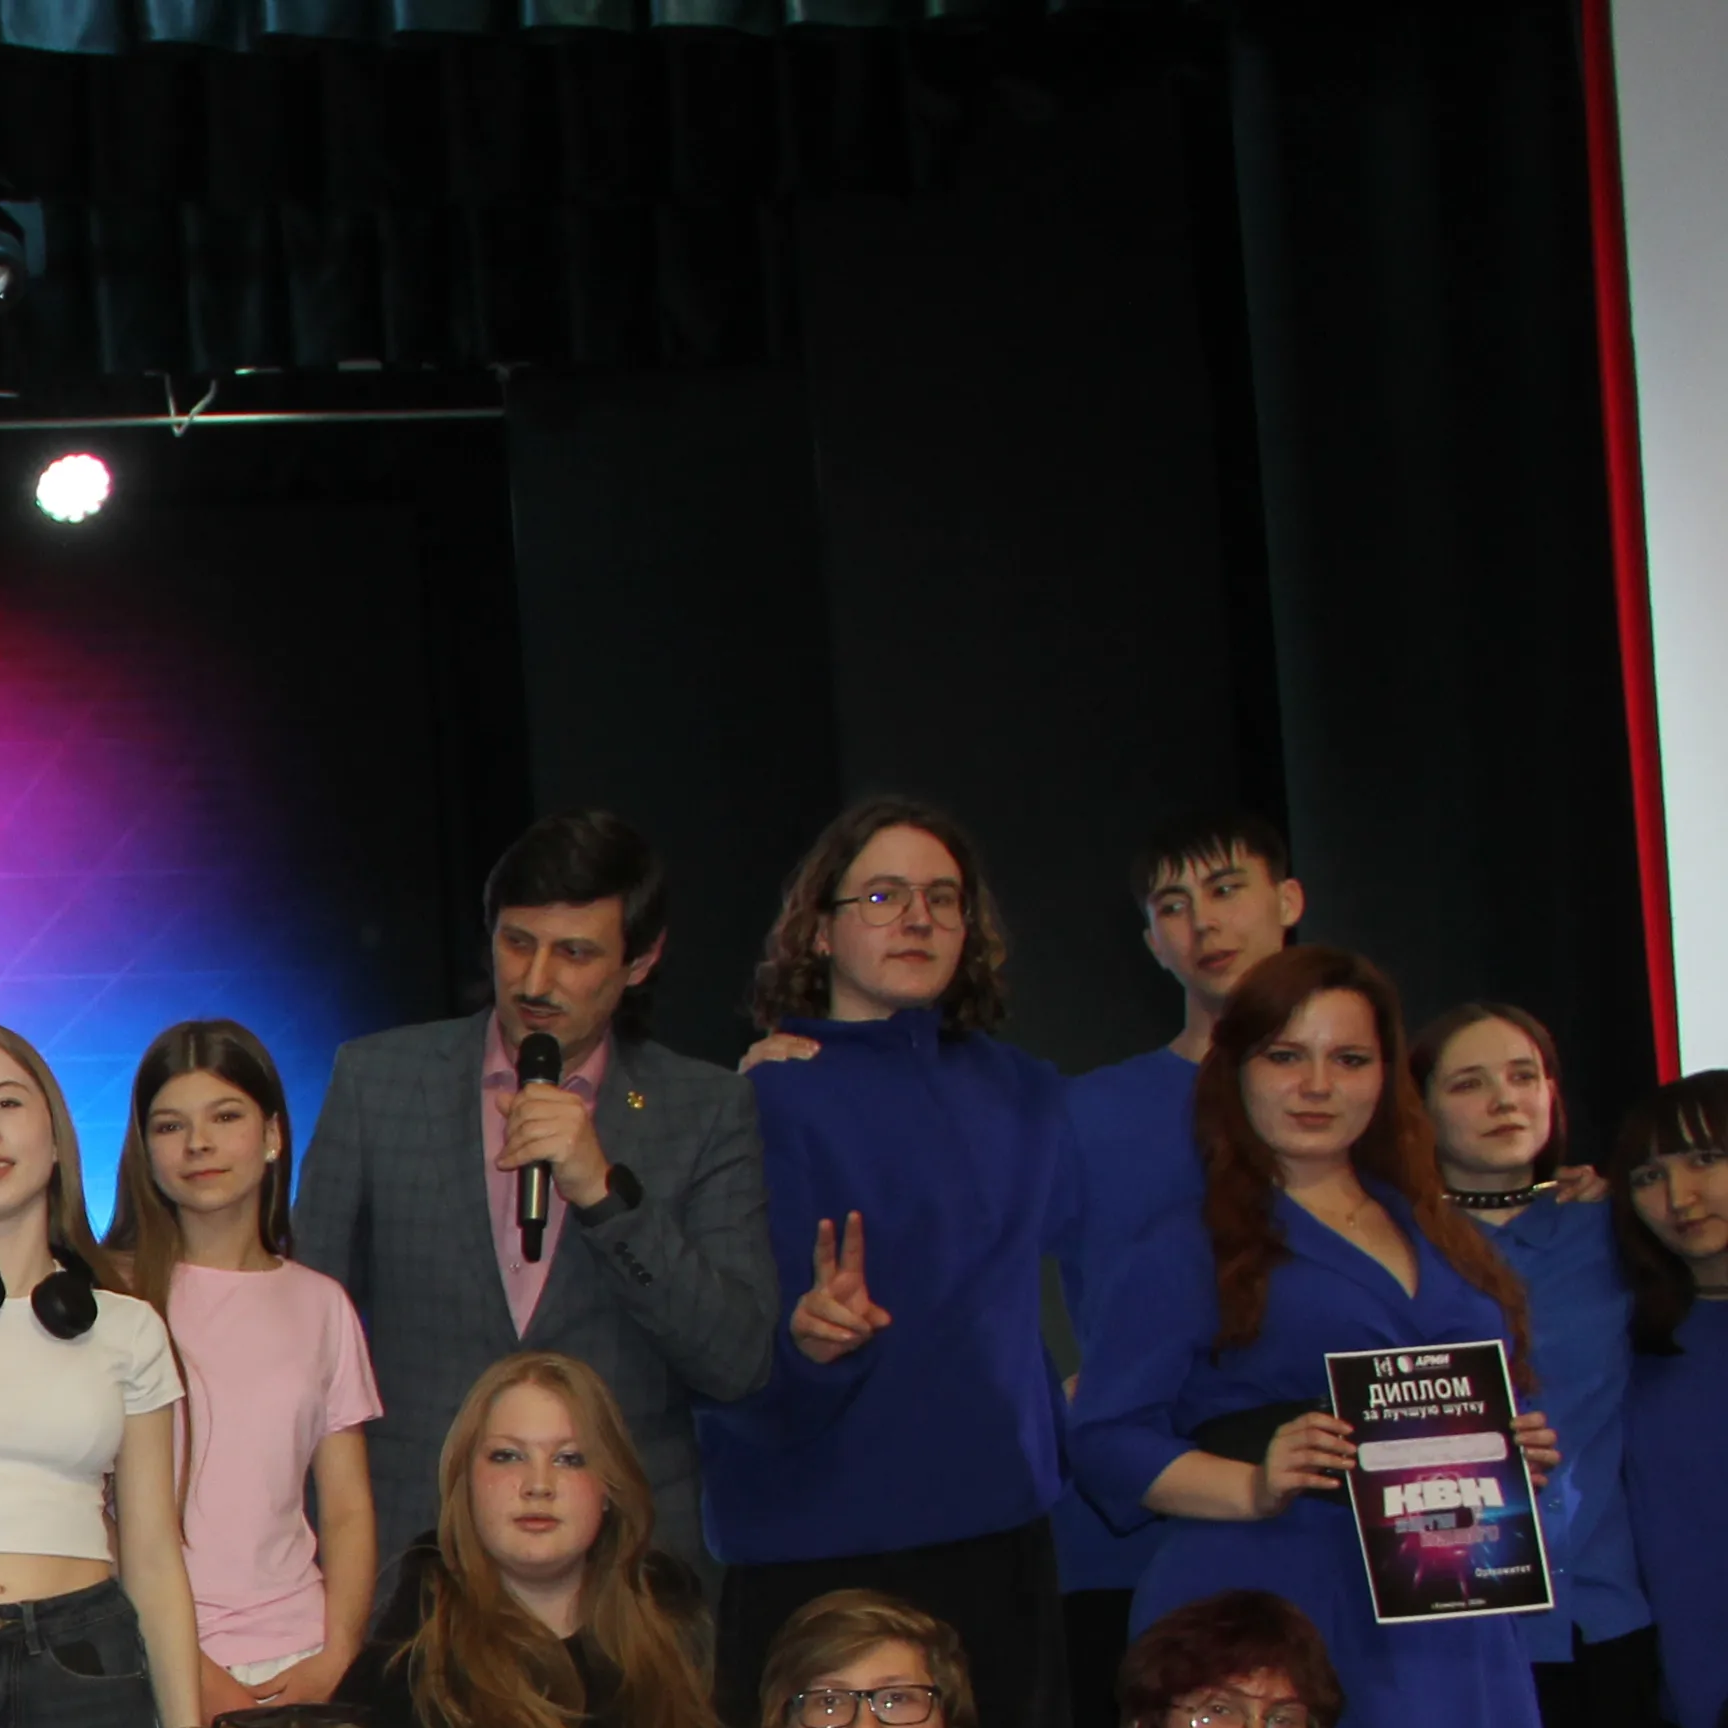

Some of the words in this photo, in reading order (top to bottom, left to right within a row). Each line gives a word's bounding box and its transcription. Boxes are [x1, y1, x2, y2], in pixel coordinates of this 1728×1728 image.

[1415, 1354, 1450, 1368] АРМИ
[1368, 1377, 1472, 1407] ДИПЛОМ
[1363, 1409, 1379, 1420] за
[1383, 1405, 1439, 1421] лучшую
[1442, 1402, 1485, 1416] шутку
[1383, 1477, 1505, 1518] КВН
